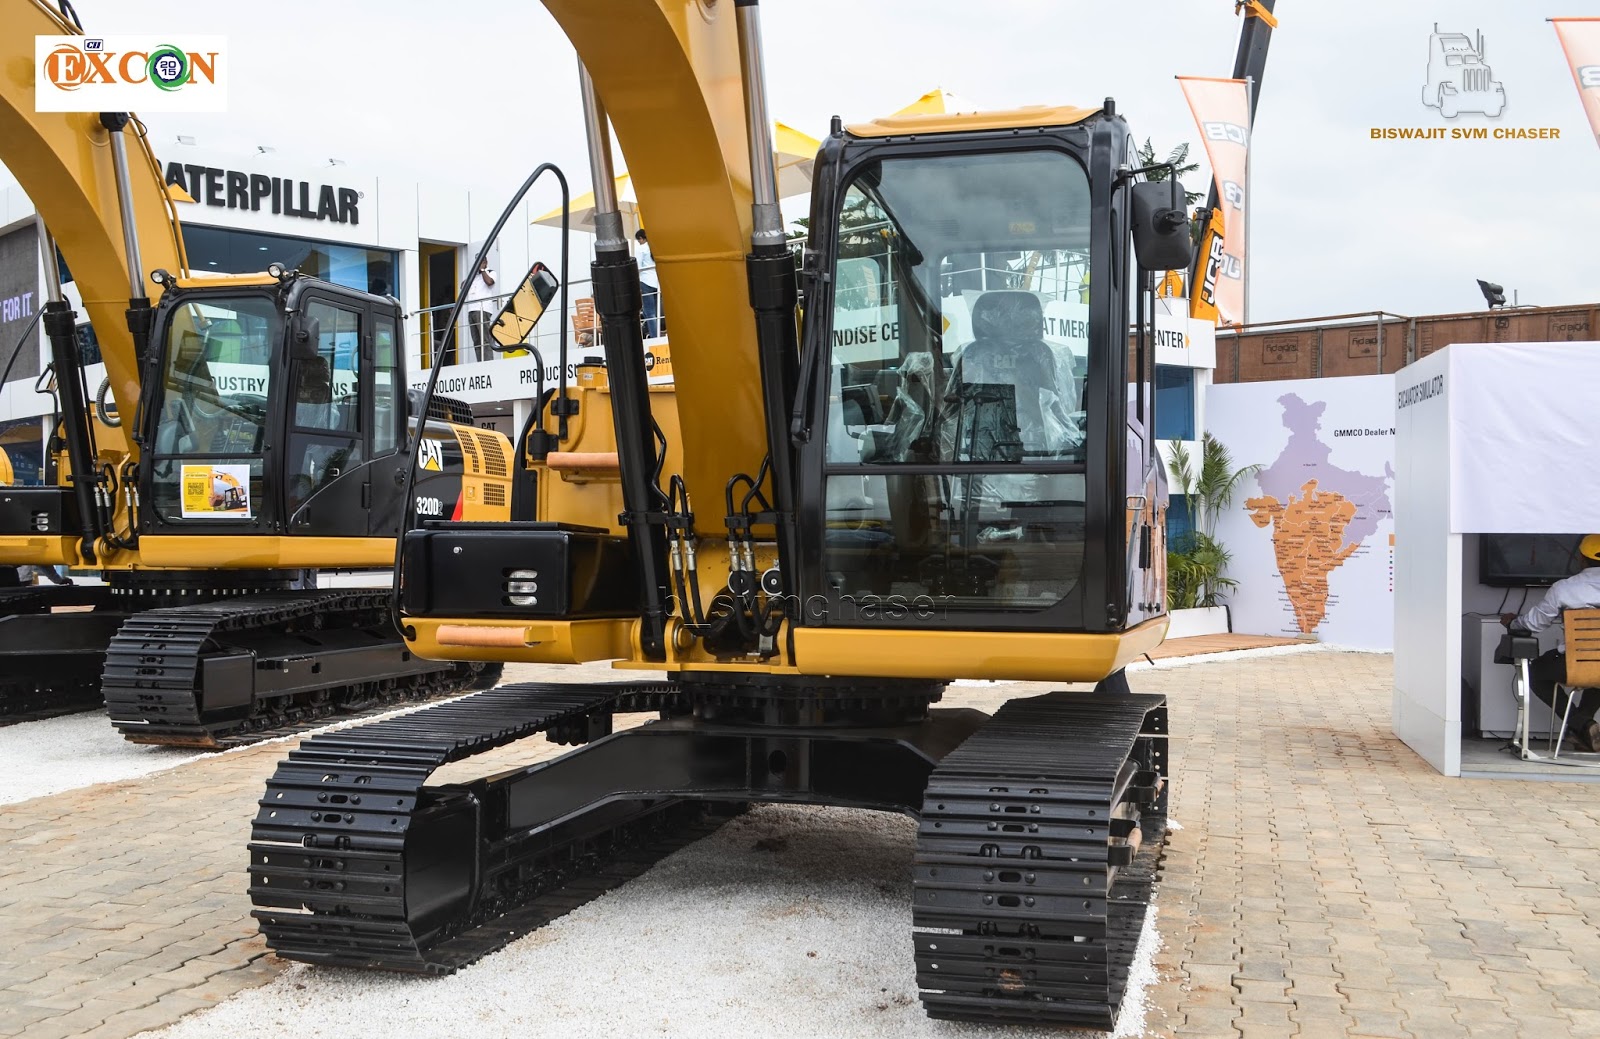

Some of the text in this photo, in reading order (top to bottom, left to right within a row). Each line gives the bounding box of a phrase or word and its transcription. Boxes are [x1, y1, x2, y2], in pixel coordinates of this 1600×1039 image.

[156, 158, 359, 225] ATERPILLAR
[3, 296, 20, 323] FOR
[1155, 329, 1183, 348] NTER
[656, 356, 671, 365] Ren
[412, 374, 492, 394] CNOLOGY AREA
[520, 365, 561, 384] PROUC
[1334, 428, 1363, 437] GMMCO
[1364, 428, 1388, 436] Dealer
[418, 438, 443, 472] CAT
